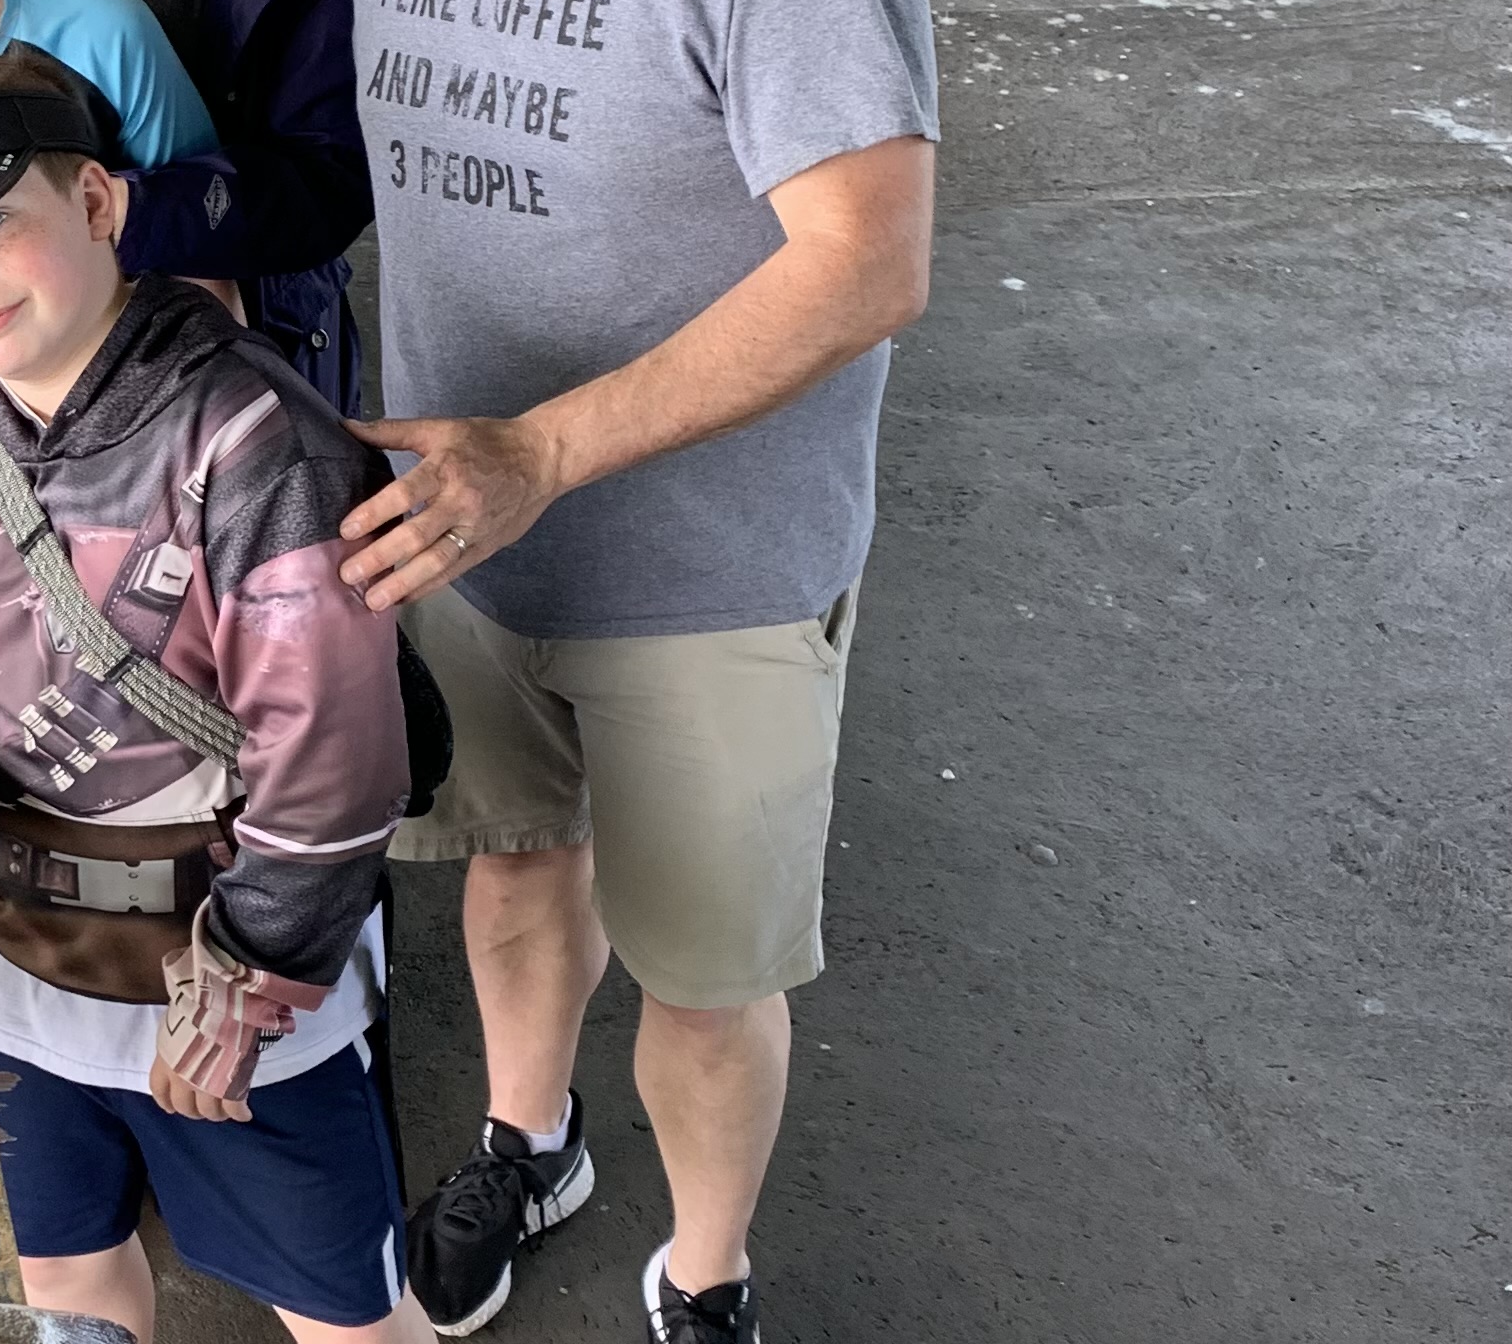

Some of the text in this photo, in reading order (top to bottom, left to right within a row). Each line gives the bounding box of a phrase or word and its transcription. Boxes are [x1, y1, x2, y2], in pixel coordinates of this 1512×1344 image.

[367, 48, 578, 143] AND MAYBE
[390, 140, 550, 217] 3 PEOPLE
